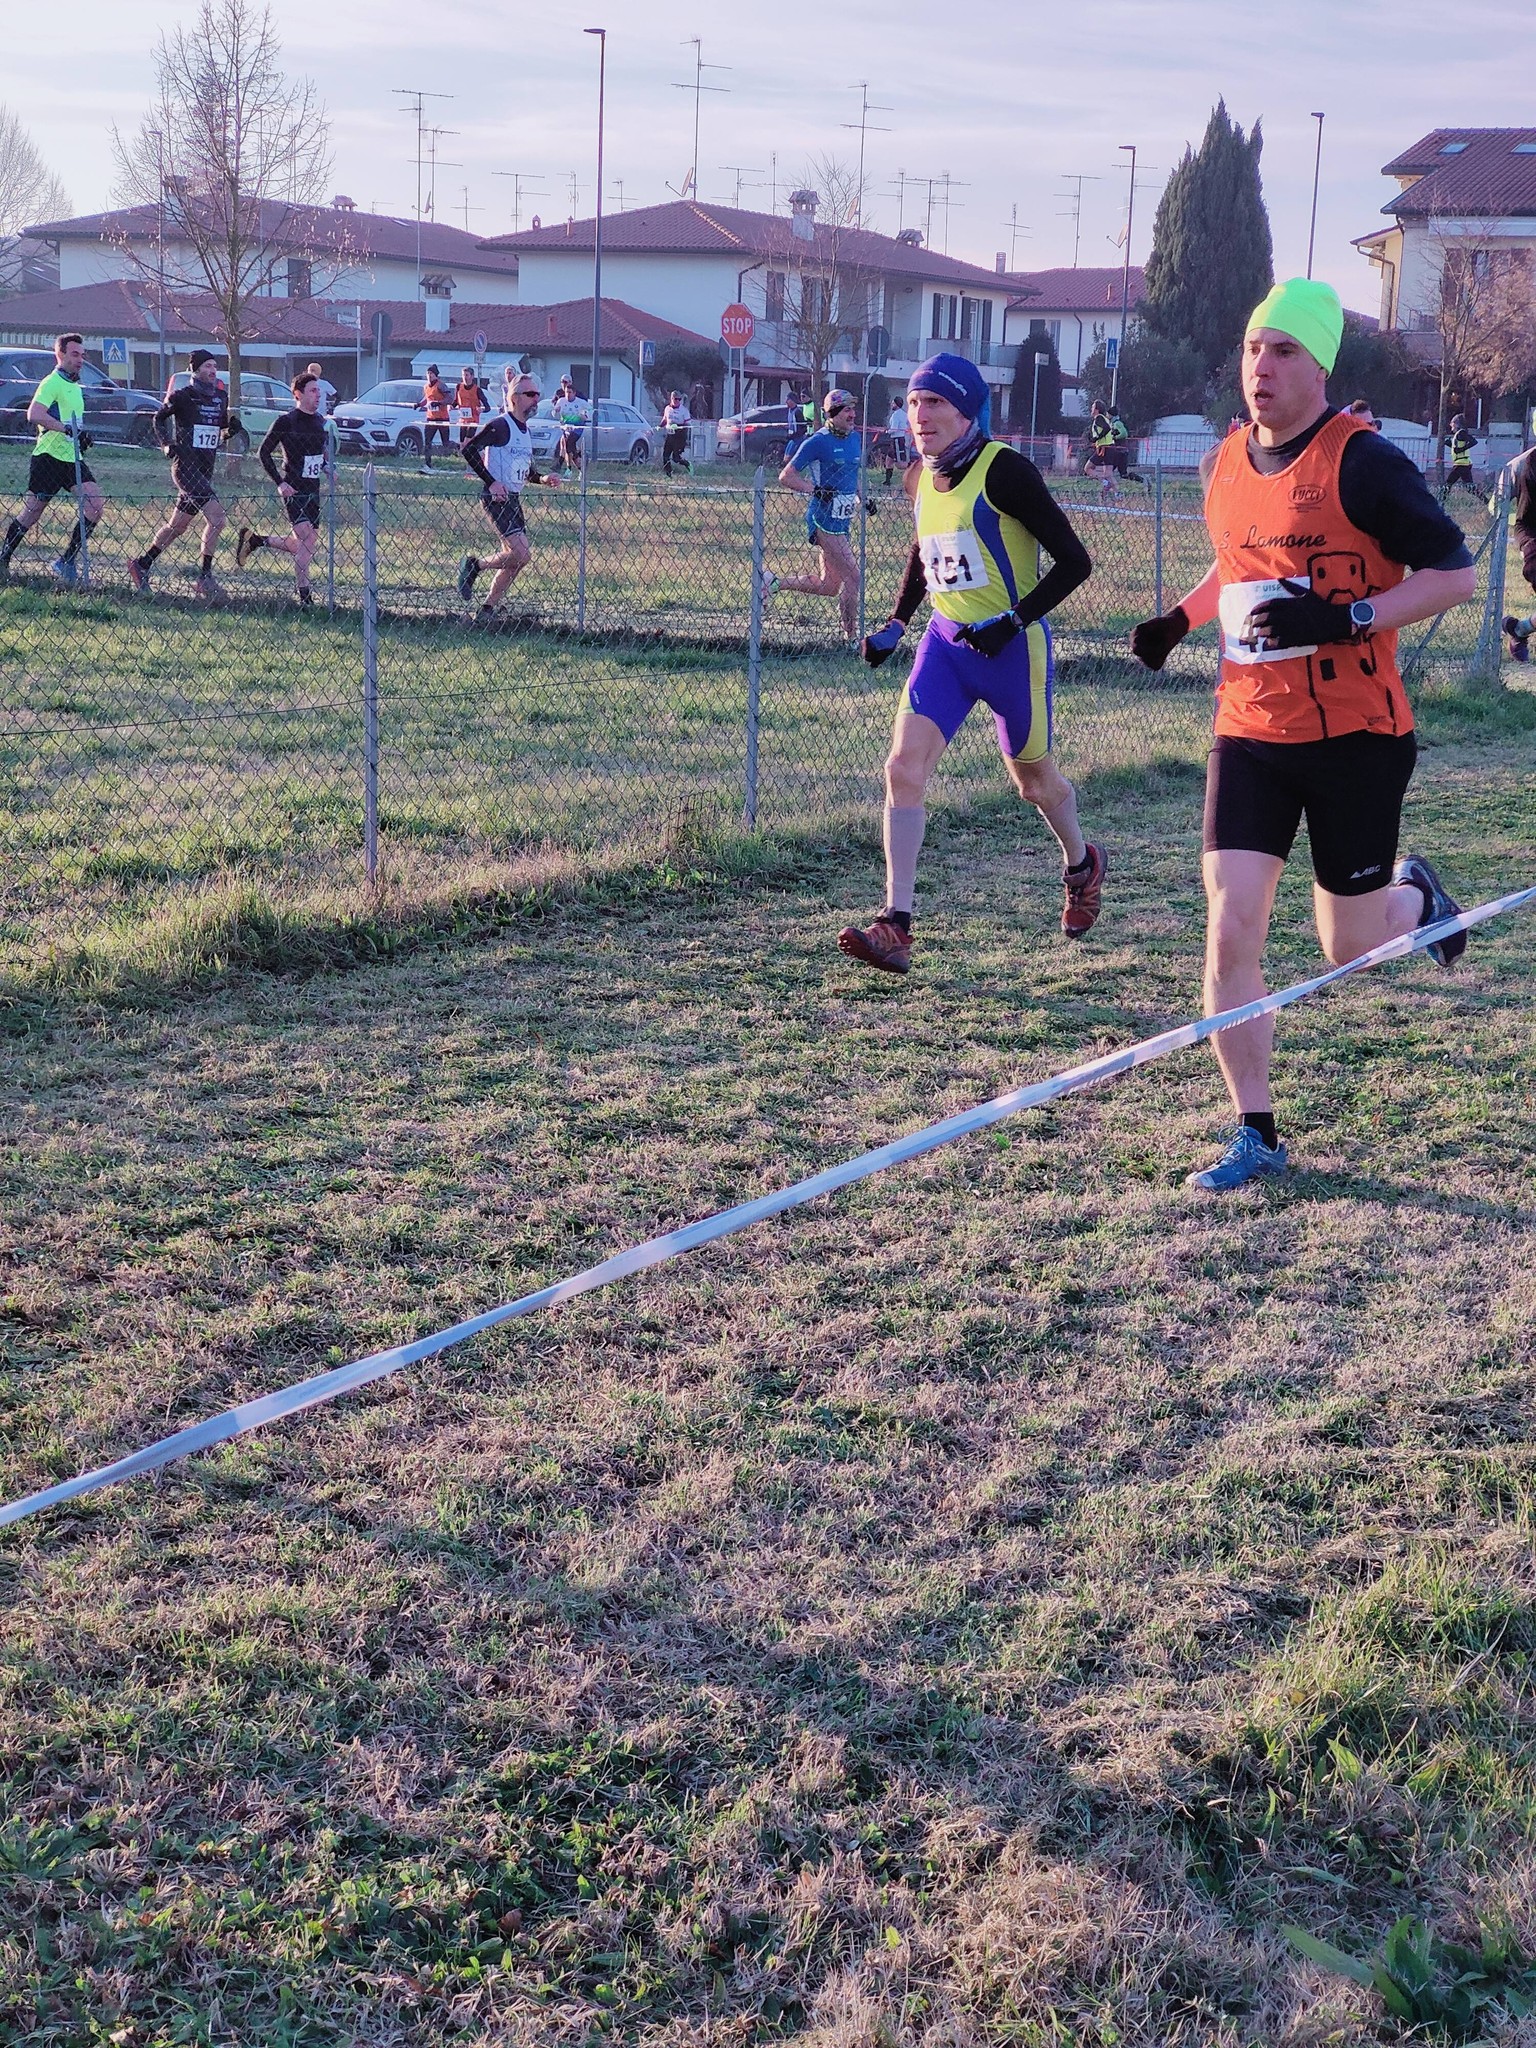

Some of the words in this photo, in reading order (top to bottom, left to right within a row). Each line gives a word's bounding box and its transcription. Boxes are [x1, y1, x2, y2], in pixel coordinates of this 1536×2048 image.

[722, 316, 752, 335] STOP
[198, 434, 217, 446] 178
[1240, 524, 1328, 549] Lamone
[930, 554, 974, 585] 151
[1360, 864, 1381, 876] ABC
